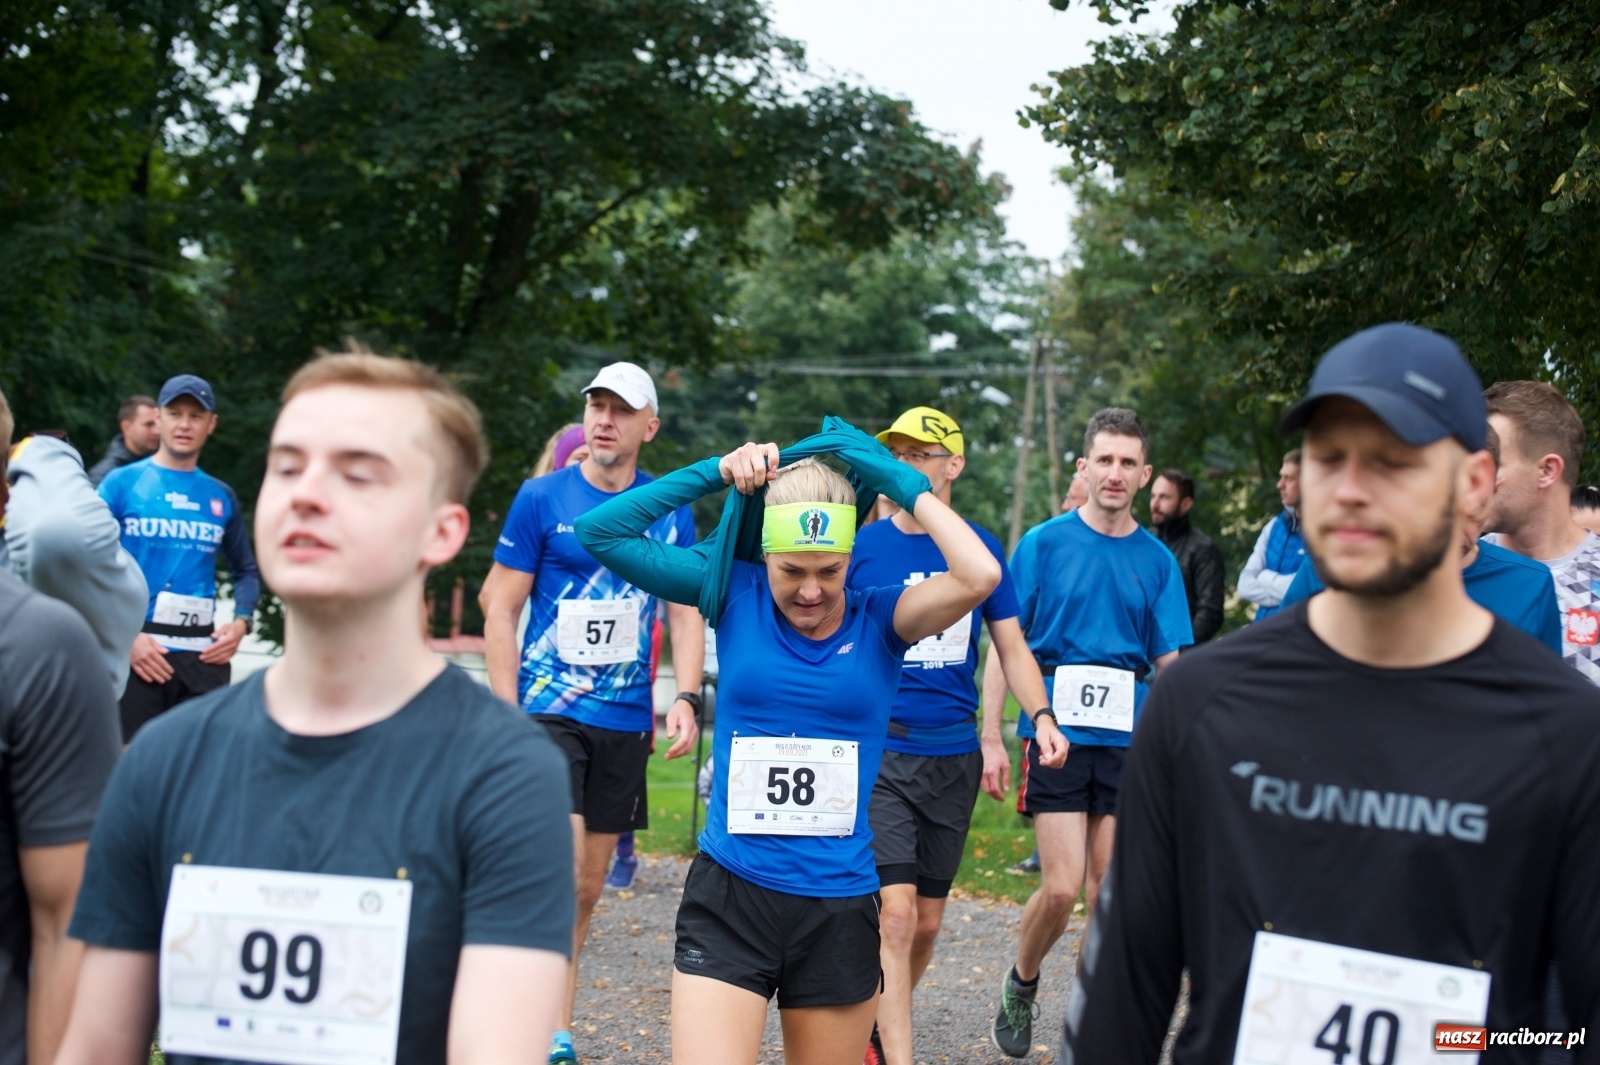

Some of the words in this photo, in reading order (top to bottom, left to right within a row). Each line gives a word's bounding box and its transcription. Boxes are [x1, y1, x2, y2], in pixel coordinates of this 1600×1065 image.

[125, 517, 224, 544] RUNNER
[587, 620, 616, 645] 57
[1081, 684, 1110, 708] 67
[767, 767, 815, 806] 58
[1251, 774, 1489, 844] RUNNING
[240, 930, 323, 1004] 99
[1314, 1004, 1399, 1065] 40
